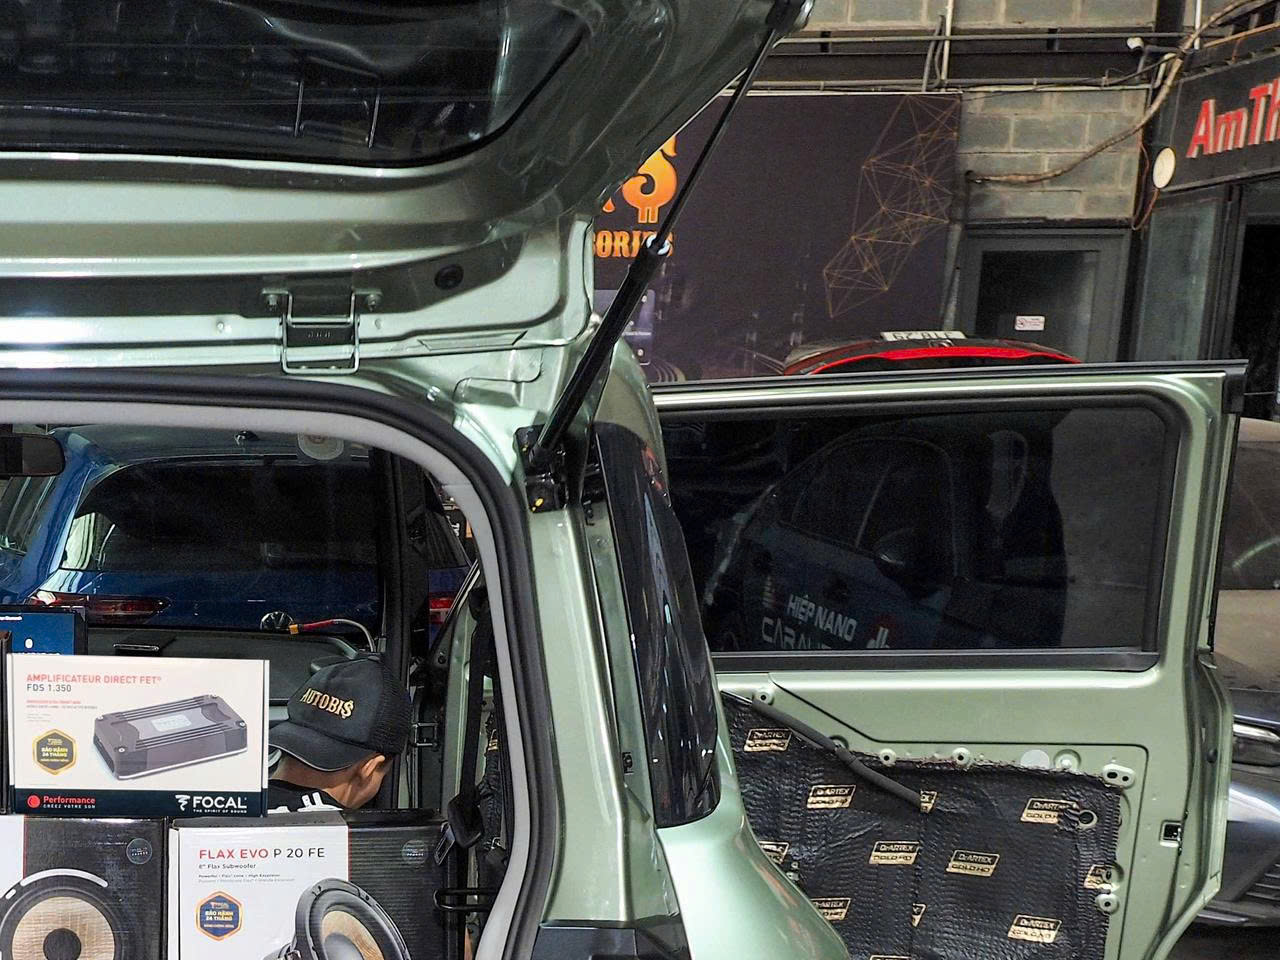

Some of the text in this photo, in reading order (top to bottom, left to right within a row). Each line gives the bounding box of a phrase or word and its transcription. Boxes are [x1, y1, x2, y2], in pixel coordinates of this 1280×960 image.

[26, 673, 101, 684] AMPLIFICATEUR
[103, 675, 137, 685] DIRECT
[26, 683, 72, 693] FDS 1.350
[43, 795, 96, 804] Performance
[193, 796, 248, 809] FOCAL
[199, 847, 325, 859] FLAX EVO P 20 FE
